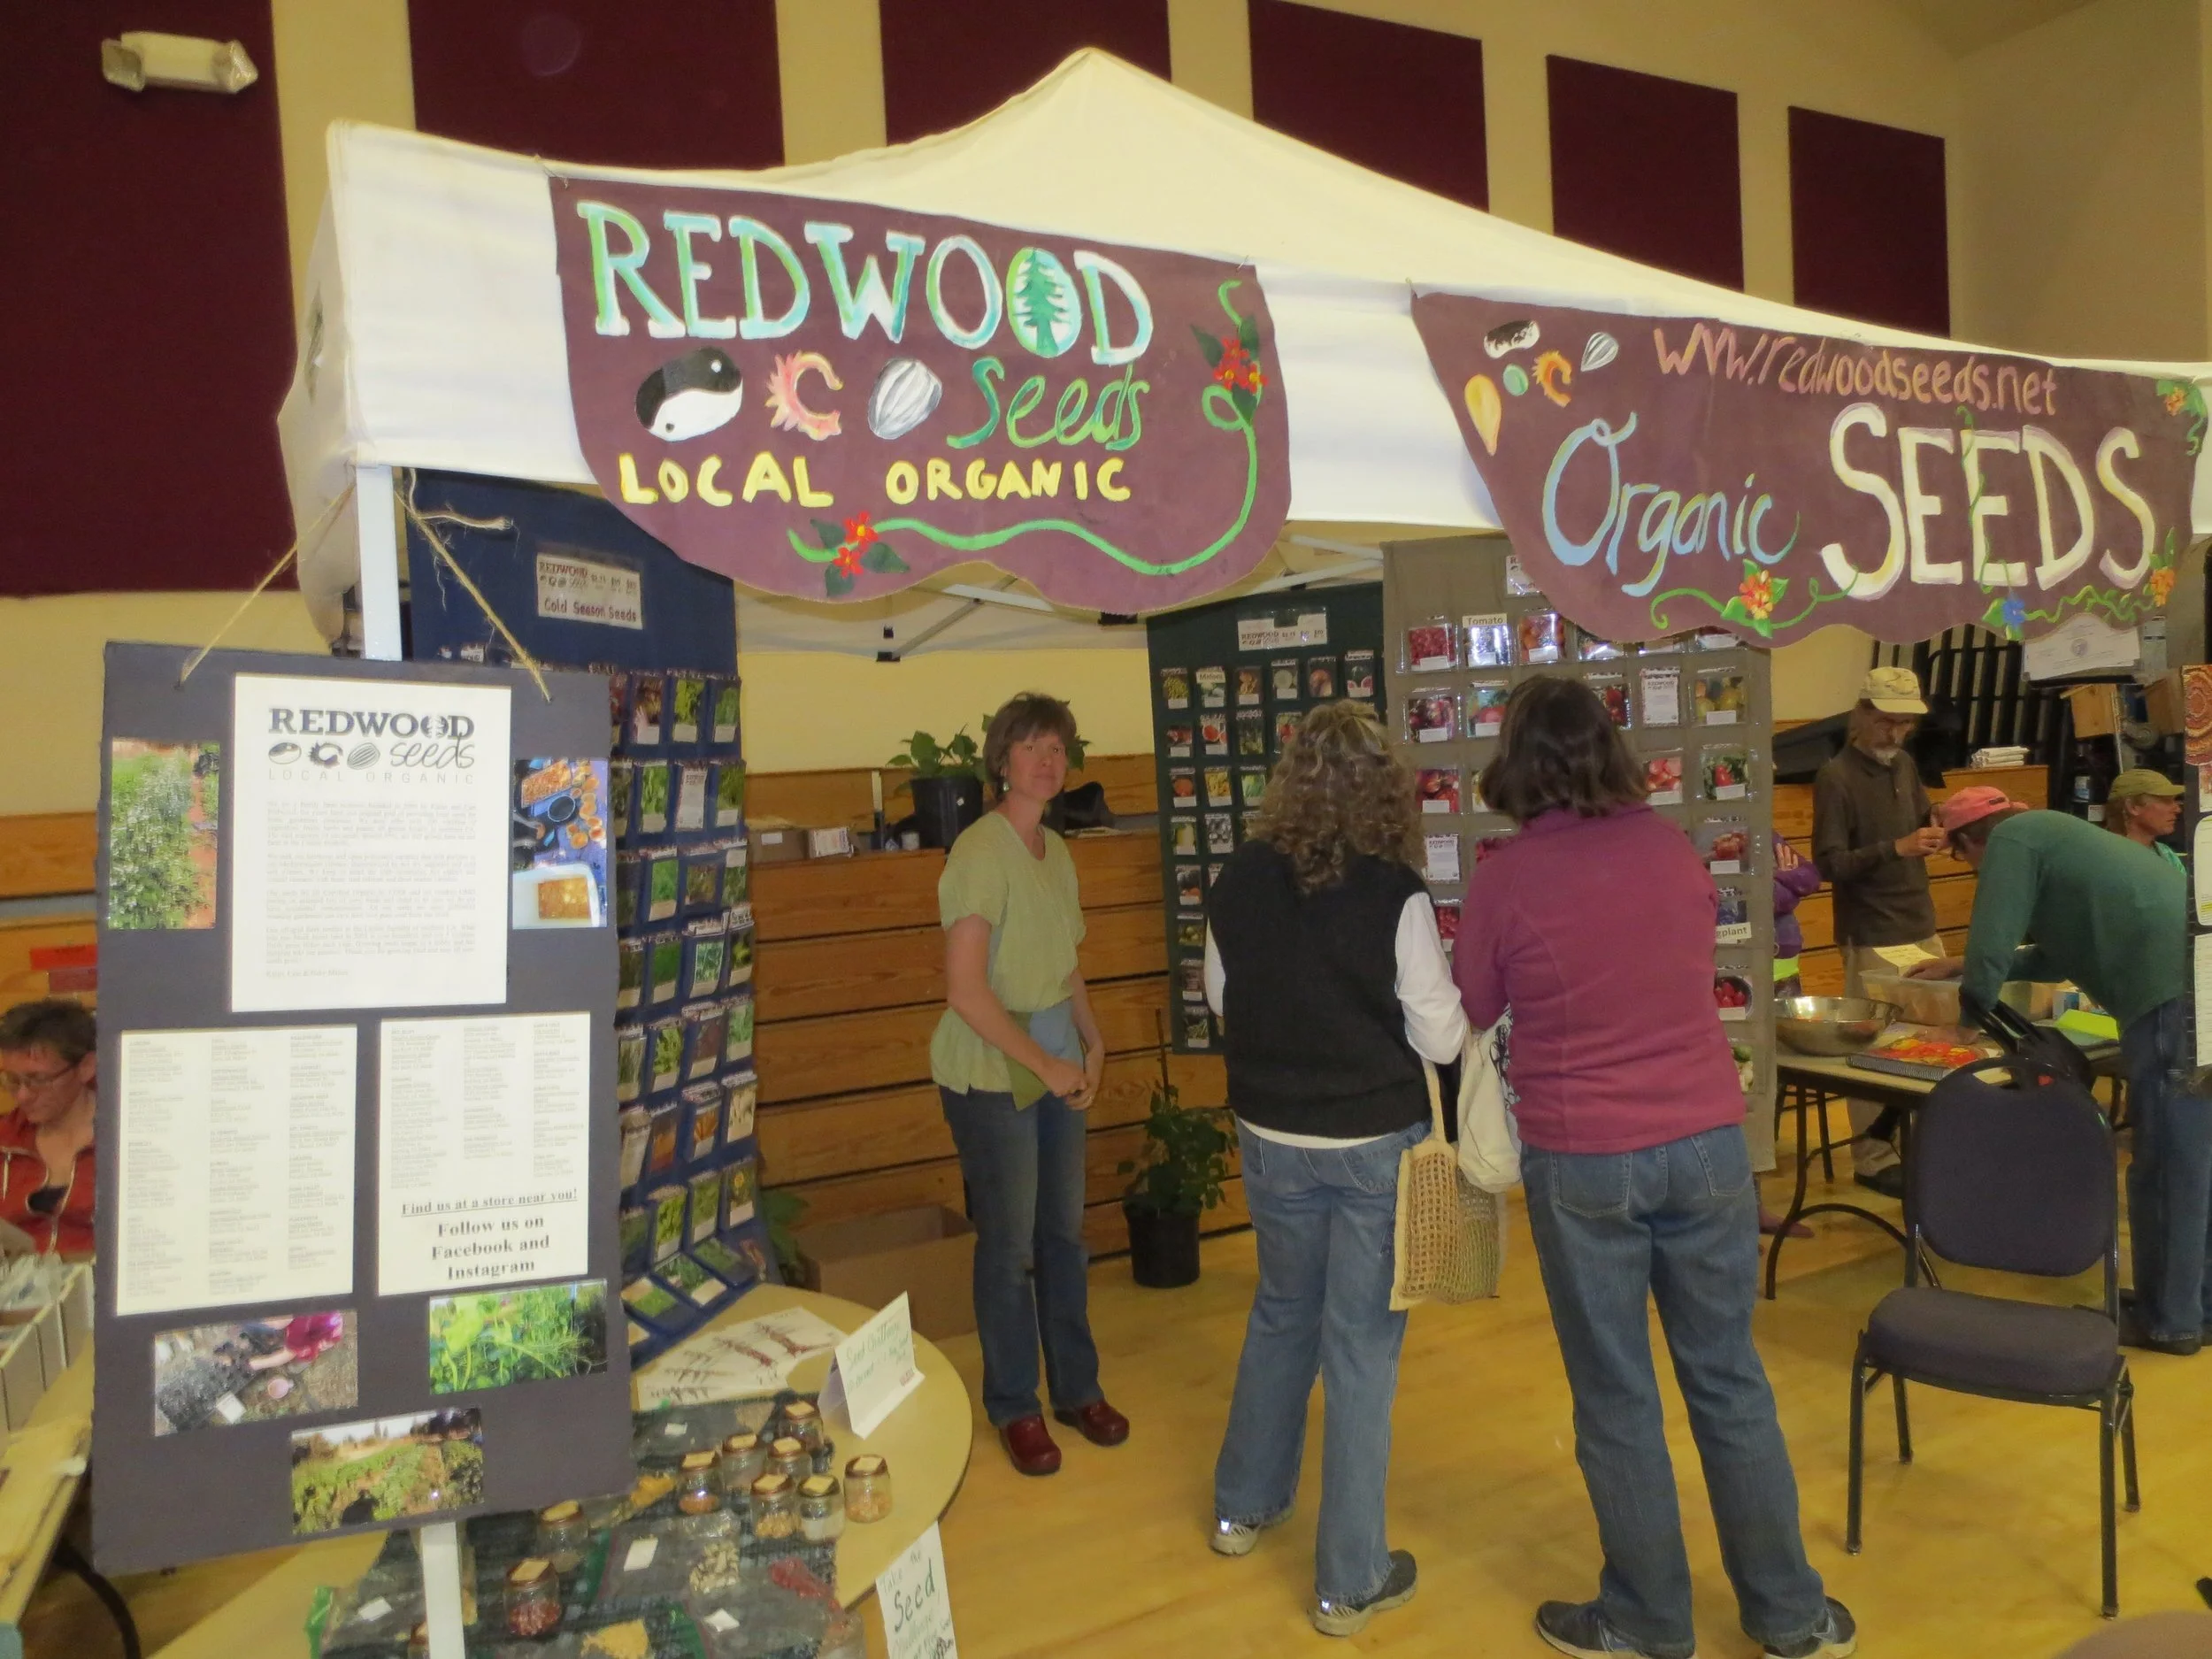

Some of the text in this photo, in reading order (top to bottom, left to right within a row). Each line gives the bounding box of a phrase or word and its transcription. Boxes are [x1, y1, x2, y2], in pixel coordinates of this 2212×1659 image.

[578, 200, 1153, 365] REDWOOD
[946, 357, 1151, 452] Seeds
[618, 451, 1133, 509] LOCAL ORGANIC
[1541, 402, 2157, 600] Organic SEEDS
[544, 597, 637, 623] Cold Season Seeds
[1466, 616, 1503, 626] Tomato
[268, 708, 475, 740] REDWOOD
[389, 732, 475, 769] seeds
[269, 768, 474, 785] LOCAL ORGANIC
[1716, 926, 1748, 939] gplant
[402, 1188, 578, 1216] Find us at a store near you!
[438, 1215, 544, 1238] Follow us on
[431, 1235, 549, 1261] Facebook and
[448, 1259, 535, 1281] Instagram
[894, 1557, 935, 1632] Seed
